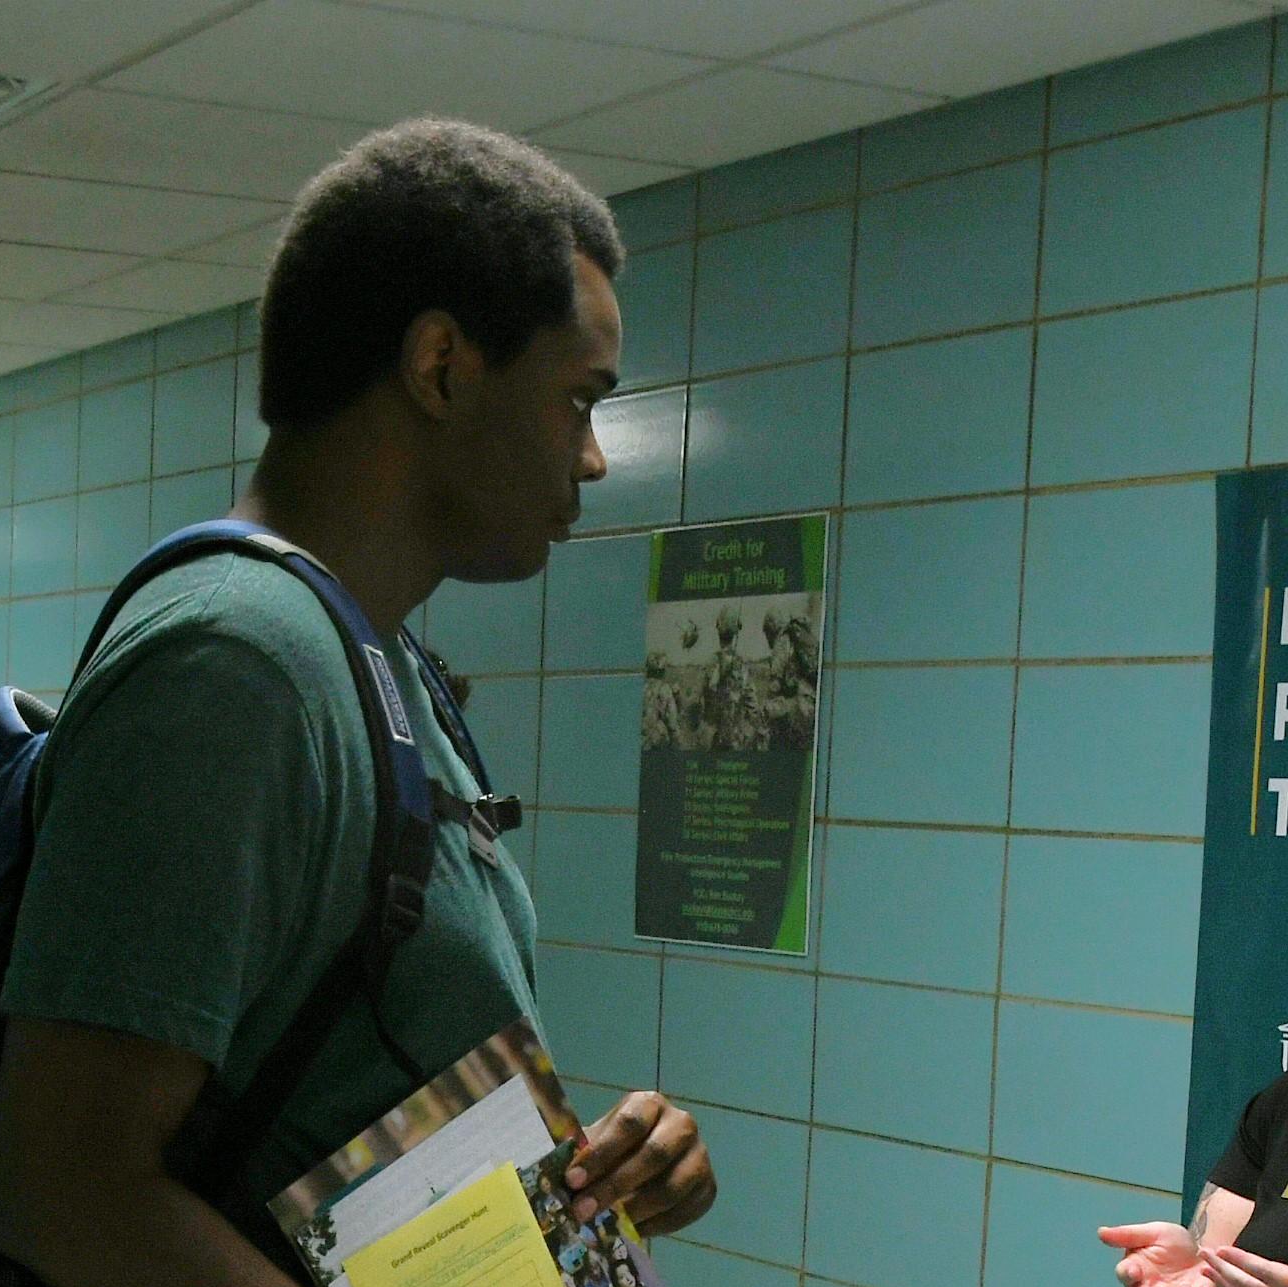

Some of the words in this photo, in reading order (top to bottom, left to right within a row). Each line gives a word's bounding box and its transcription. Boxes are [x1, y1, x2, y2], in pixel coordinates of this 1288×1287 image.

[734, 566, 785, 591] Training
[389, 1251, 414, 1269] Grand
[434, 1216, 472, 1242] Scavenger
